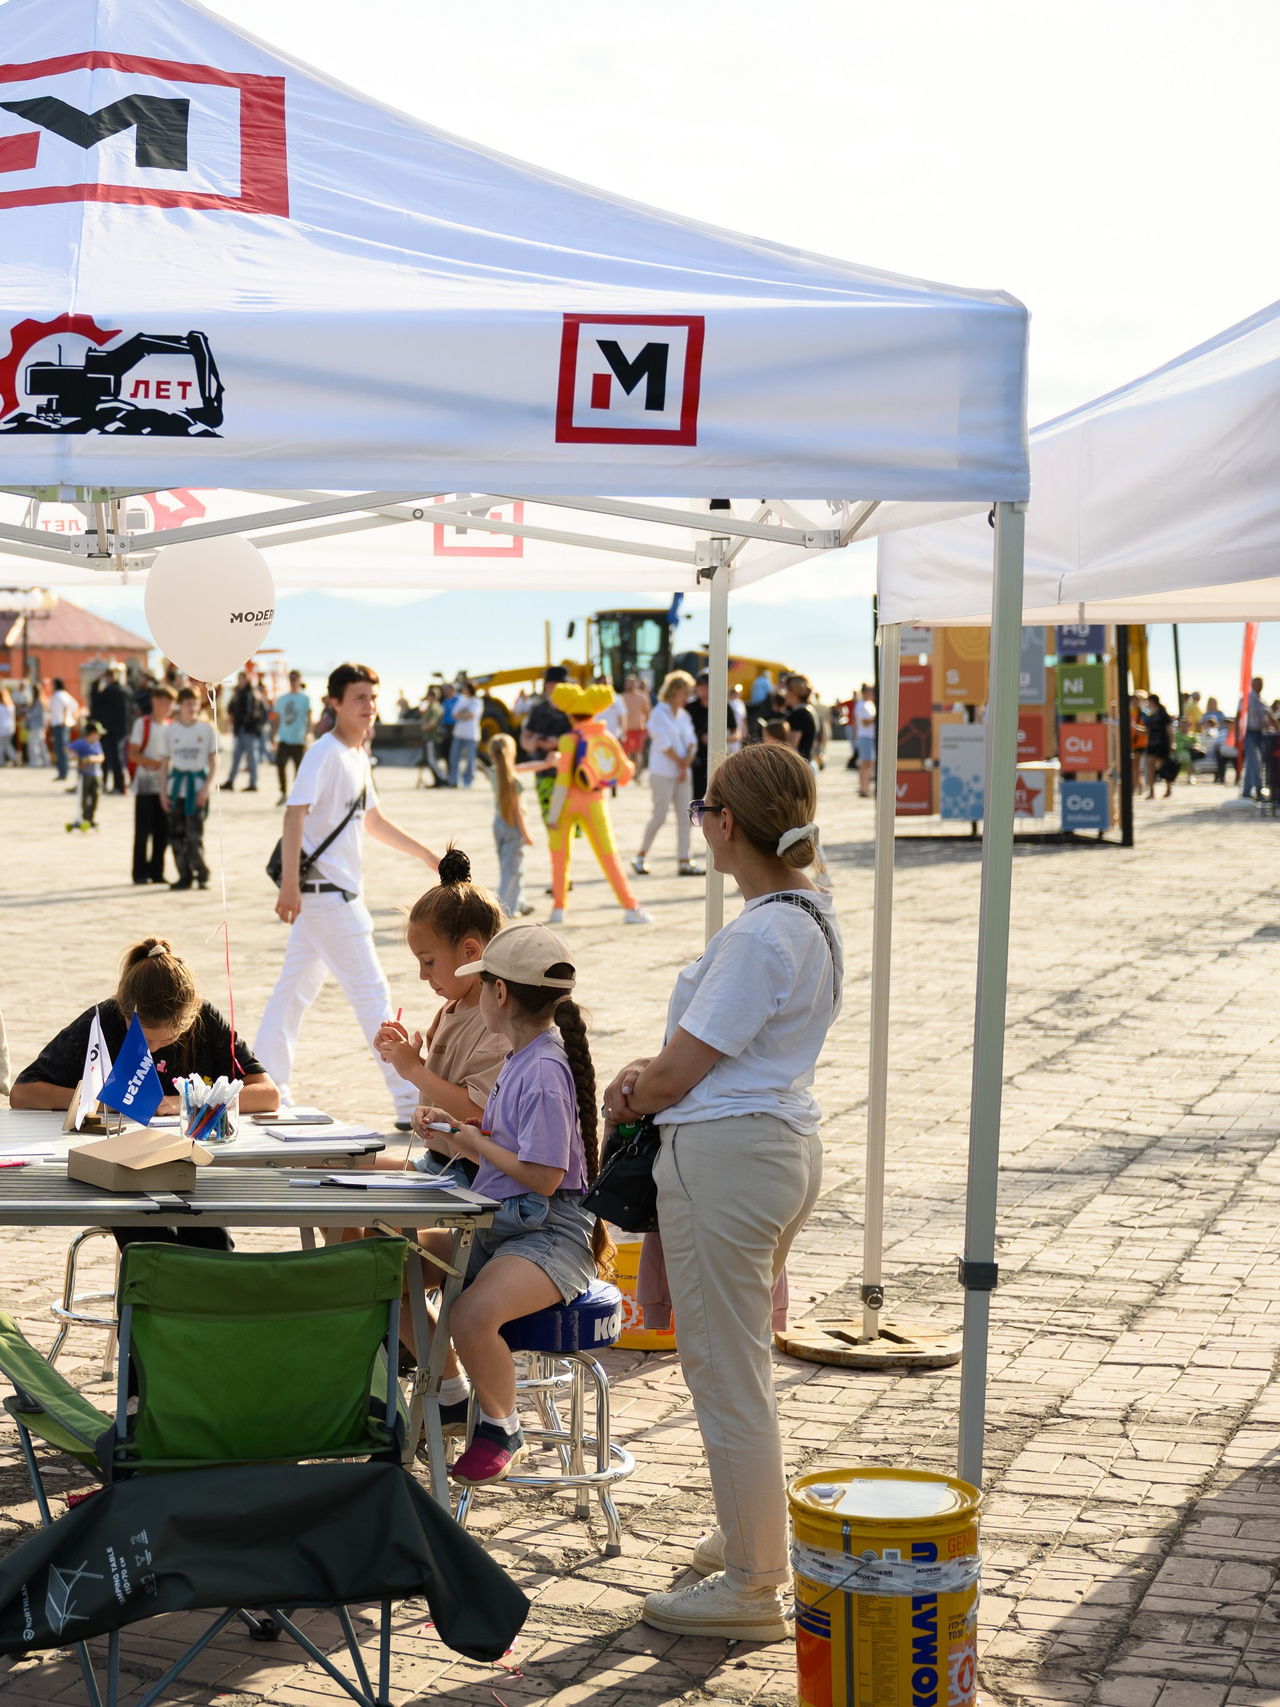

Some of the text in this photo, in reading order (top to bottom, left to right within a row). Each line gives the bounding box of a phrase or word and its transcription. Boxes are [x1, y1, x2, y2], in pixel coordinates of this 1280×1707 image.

[130, 379, 193, 400] ЛЕТ
[230, 609, 274, 623] MODER
[1063, 678, 1084, 694] Ni
[1064, 736, 1093, 752] Cu
[1066, 795, 1095, 811] Co
[948, 1533, 976, 1553] GENU
[916, 1566, 942, 1575] MODERN
[21, 1584, 33, 1629] NORTHLAN
